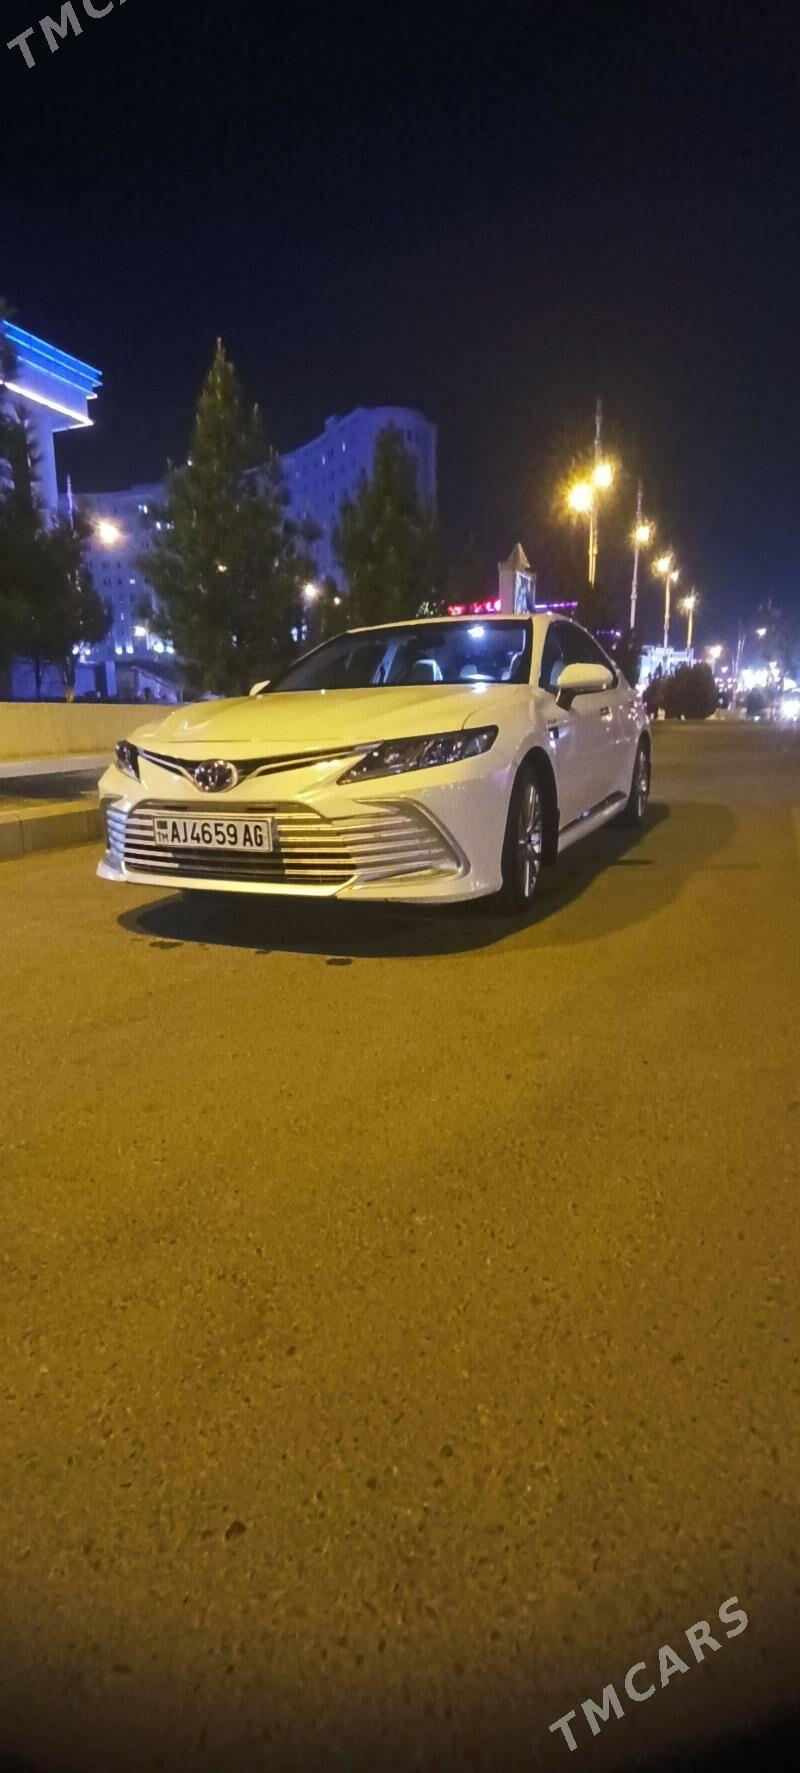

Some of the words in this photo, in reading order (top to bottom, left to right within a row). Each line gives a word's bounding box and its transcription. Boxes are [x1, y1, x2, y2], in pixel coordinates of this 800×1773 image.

[156, 832, 169, 843] TM
[171, 821, 238, 846] AJ4659
[242, 824, 264, 847] AG
